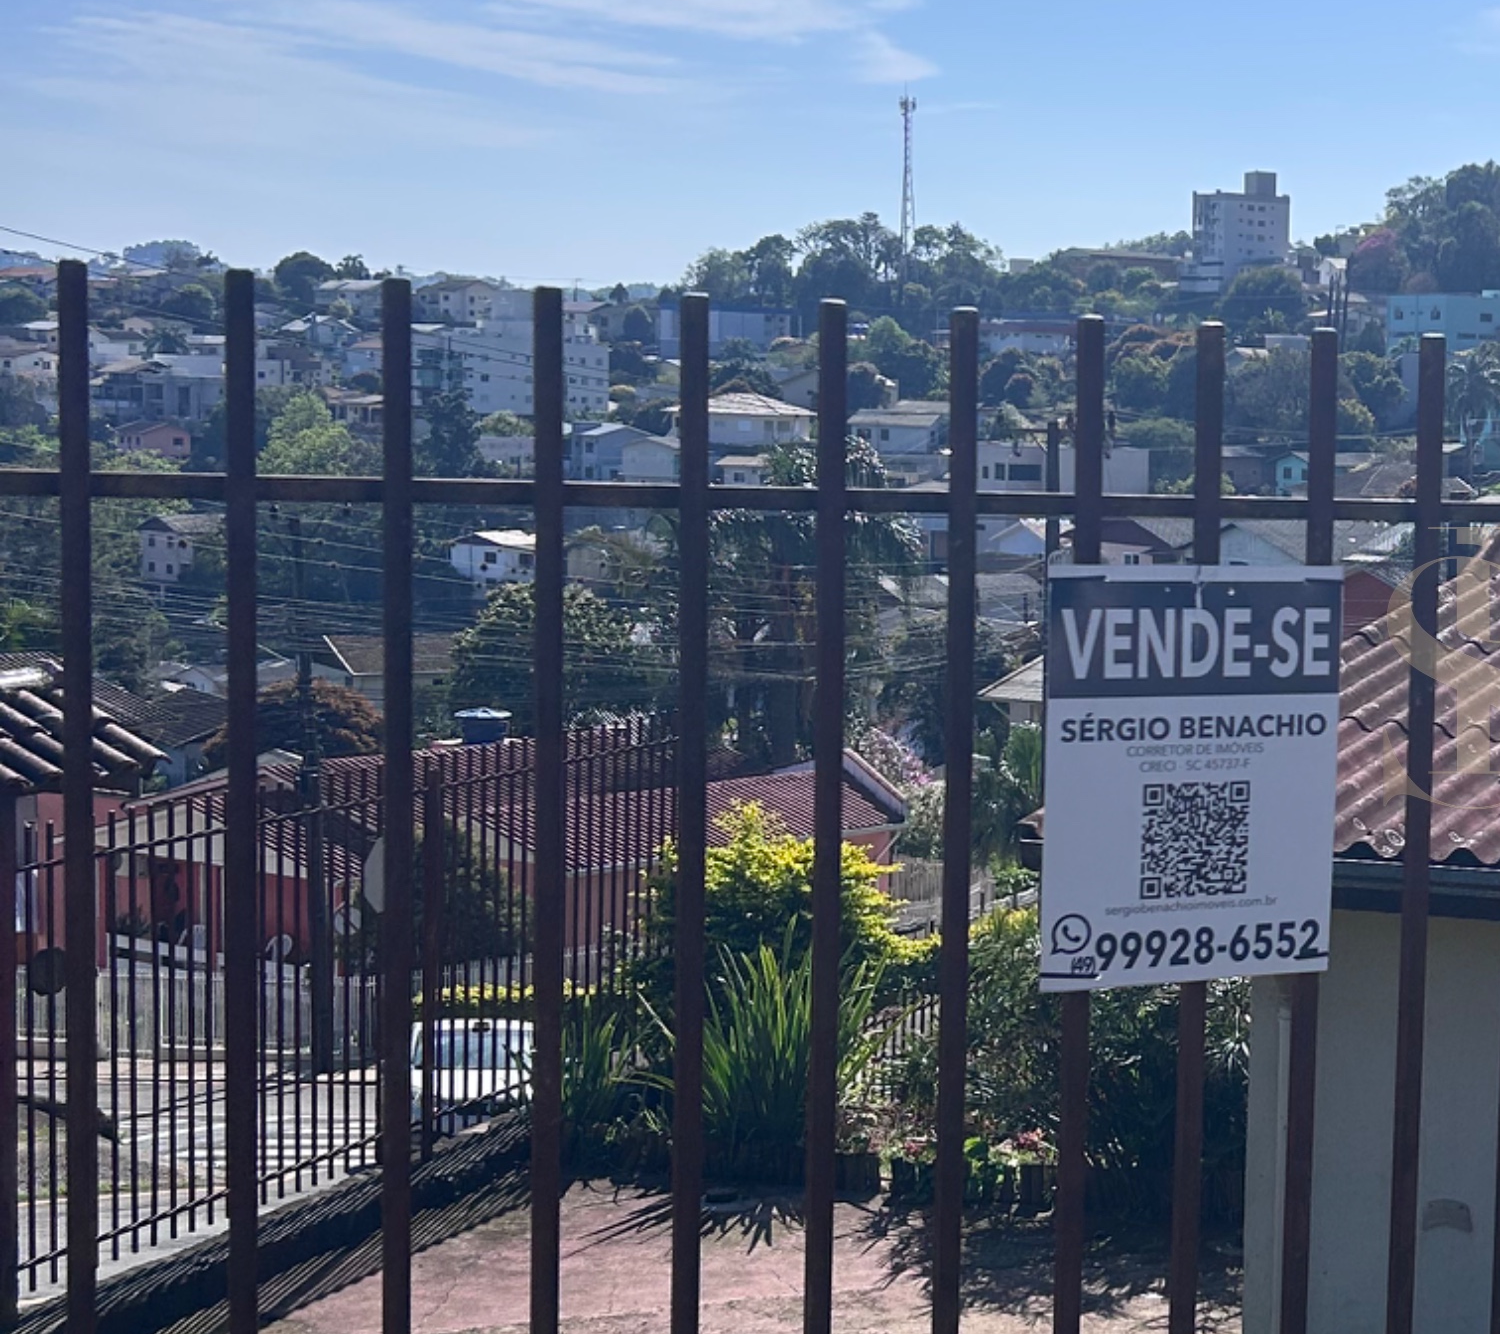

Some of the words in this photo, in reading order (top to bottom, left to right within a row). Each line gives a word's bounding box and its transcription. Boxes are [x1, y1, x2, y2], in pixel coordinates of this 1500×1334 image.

[1061, 606, 1331, 680] VENDE-SE
[1060, 712, 1171, 743] SÉRGIO
[1179, 713, 1327, 740] BENACHIO
[1126, 744, 1193, 757] CORRETOR
[1196, 744, 1212, 756] DE
[1215, 741, 1265, 754] IMÓVEIS
[1139, 760, 1177, 773] CRECI
[1185, 759, 1202, 771] SC
[1105, 896, 1278, 918] sergiobenachioimoveis.com.br
[1071, 956, 1096, 974] (49)
[1095, 919, 1321, 972] 99928-6552
